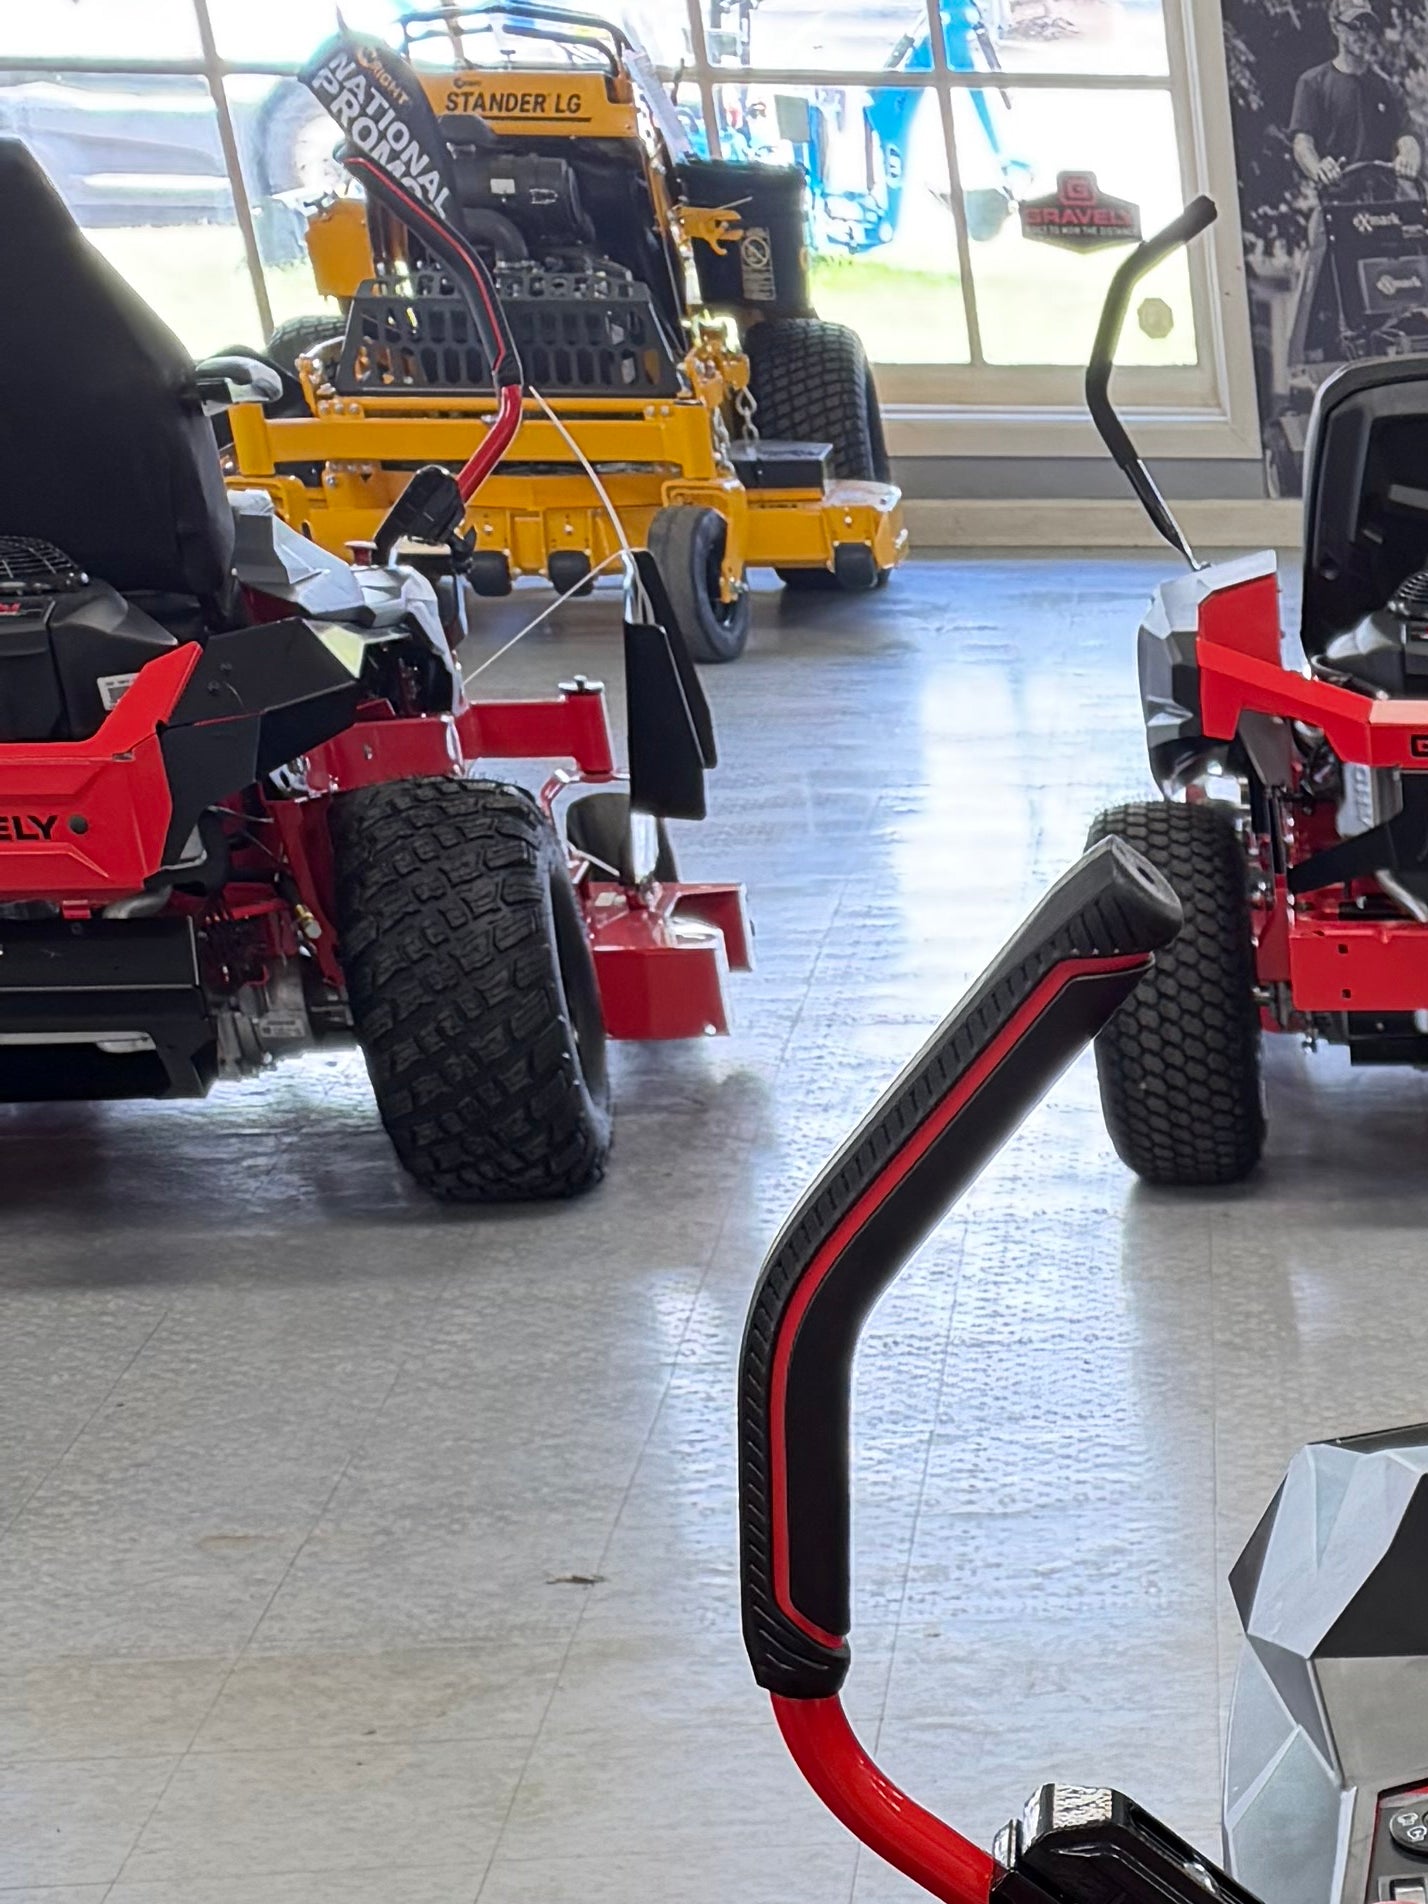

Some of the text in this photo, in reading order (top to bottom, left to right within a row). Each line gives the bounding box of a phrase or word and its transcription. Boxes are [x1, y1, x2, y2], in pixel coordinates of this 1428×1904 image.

[445, 91, 582, 113] STANDER LG
[329, 52, 450, 219] NATIONAL
[0, 815, 58, 841] LY
